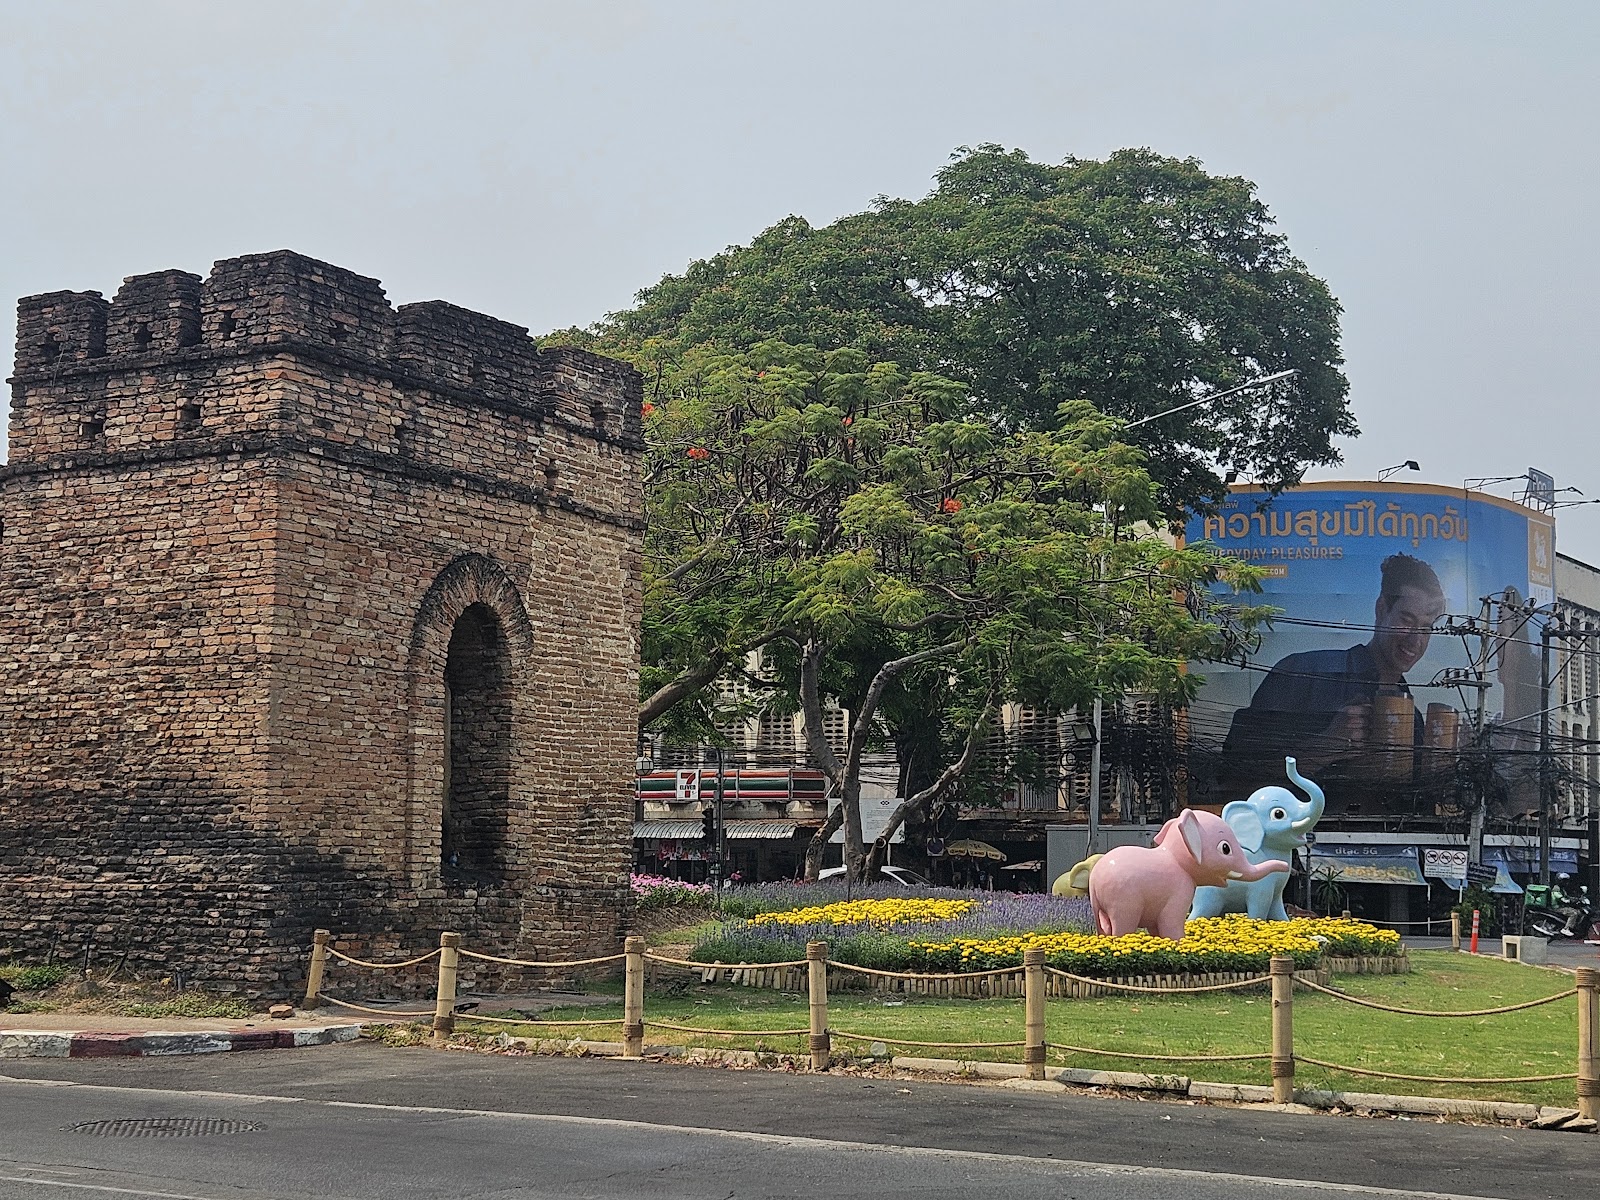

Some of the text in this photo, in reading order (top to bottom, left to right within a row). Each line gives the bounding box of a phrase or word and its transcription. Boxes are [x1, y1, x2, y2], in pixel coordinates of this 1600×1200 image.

[1204, 500, 1468, 547] ความสุขมีได้ทุกวัน
[1271, 546, 1344, 560] PLEASURES
[680, 772, 696, 799] 7
[1334, 846, 1378, 855] dtac 5G
